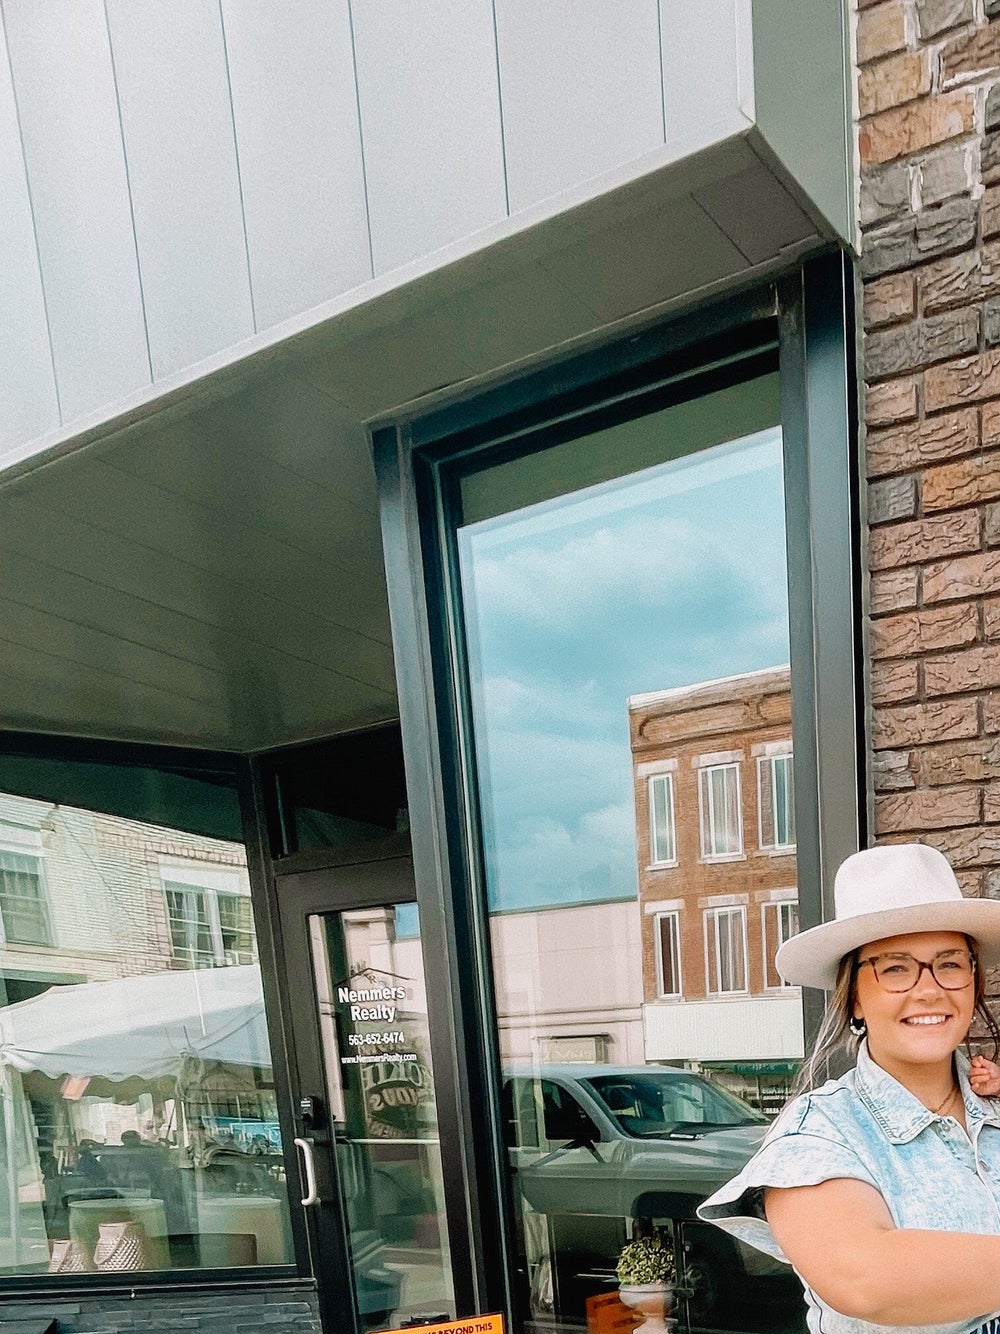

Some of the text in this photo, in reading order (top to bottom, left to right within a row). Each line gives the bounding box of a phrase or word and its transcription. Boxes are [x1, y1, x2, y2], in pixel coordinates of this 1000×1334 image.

[338, 986, 406, 1003] Nemmers
[350, 1004, 396, 1023] Realty
[348, 1031, 405, 1046] 563-652-6474
[475, 1322, 493, 1333] THIS
